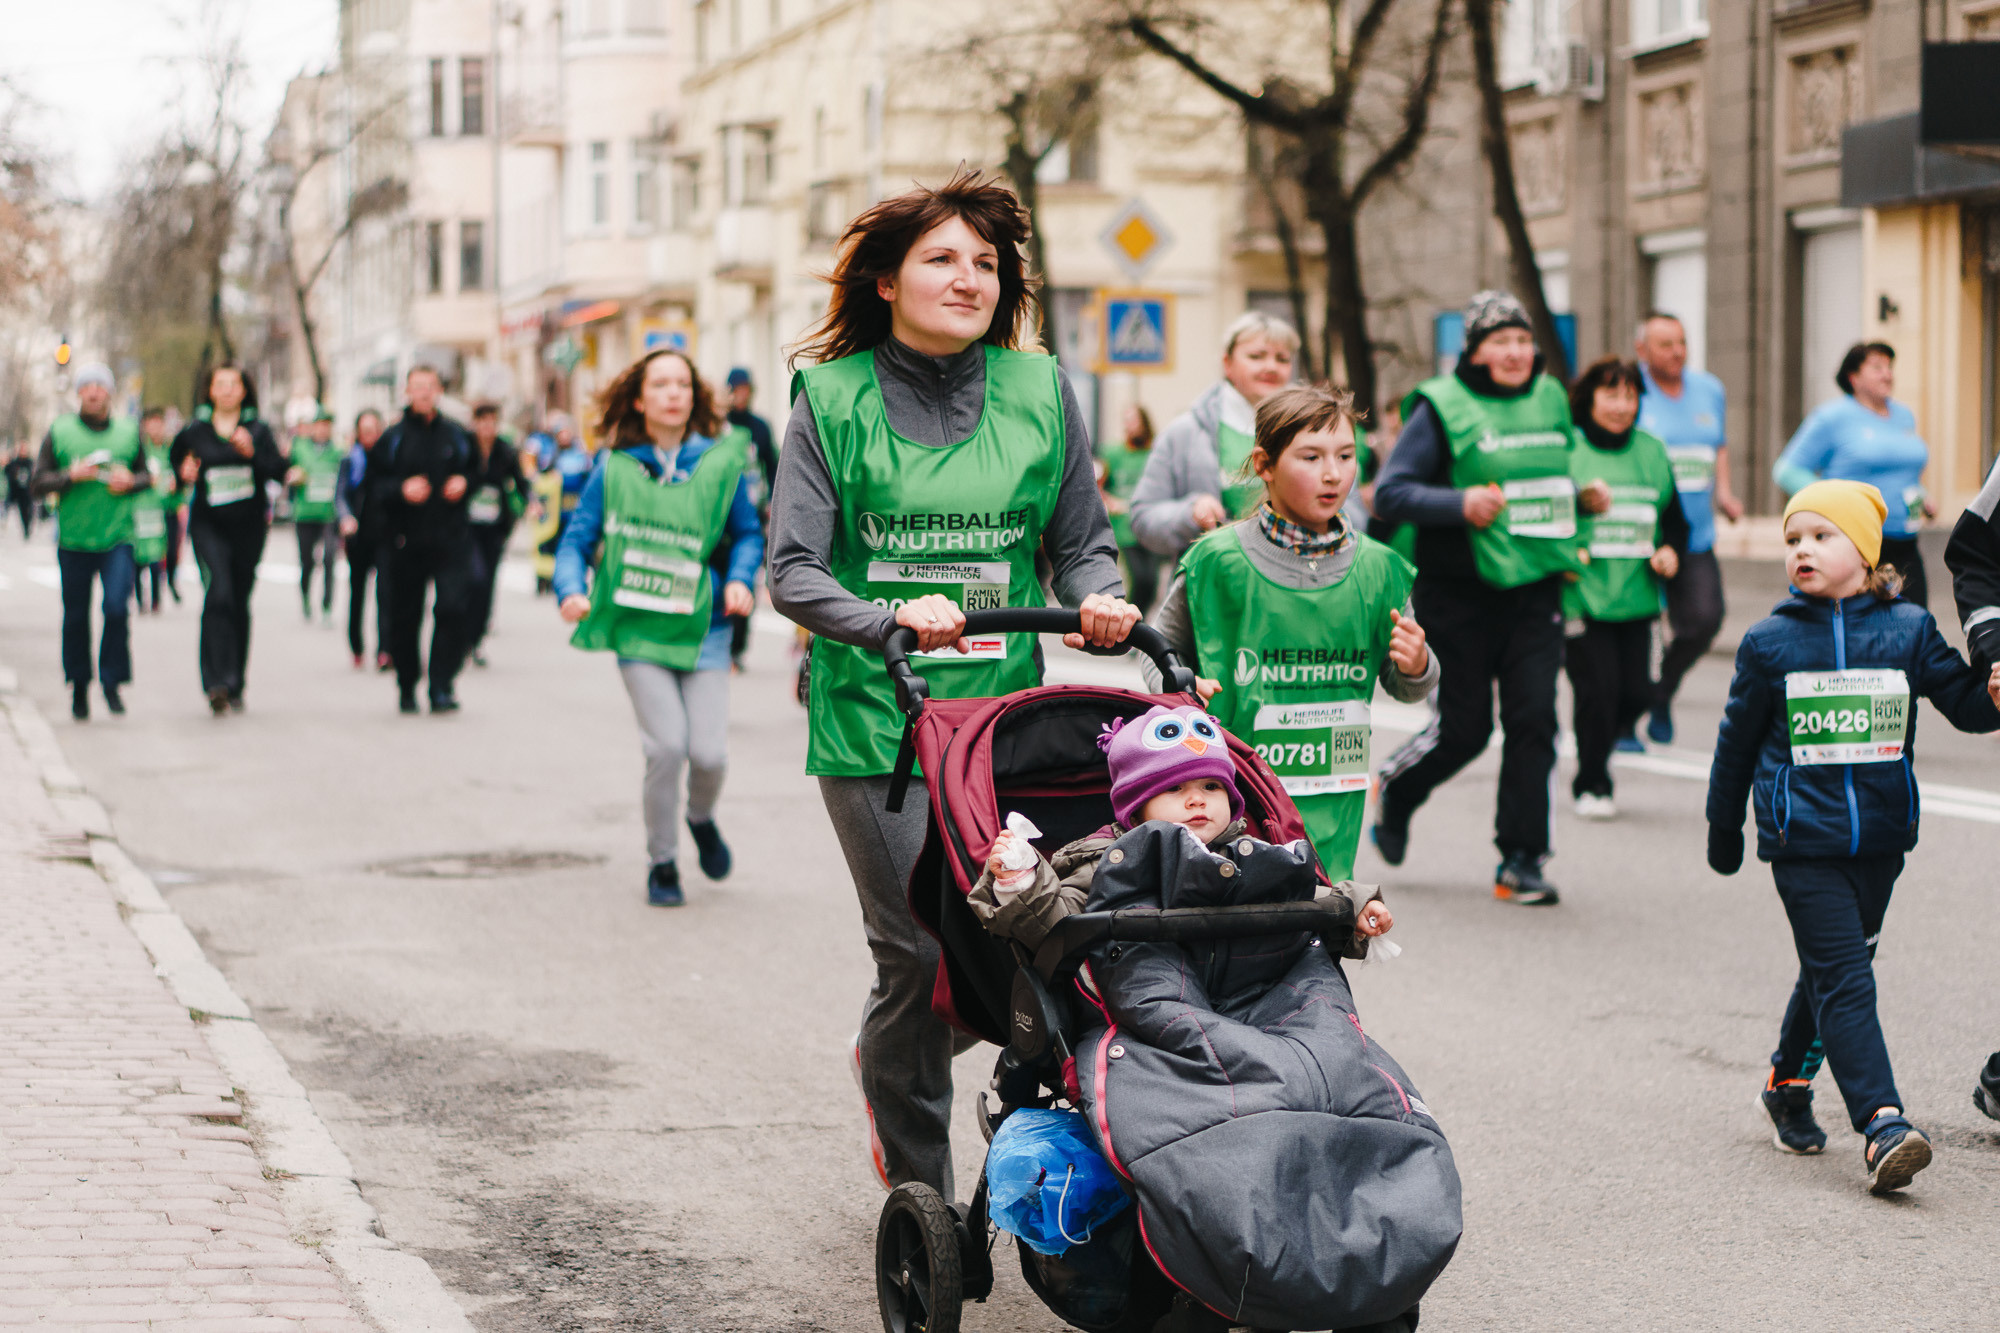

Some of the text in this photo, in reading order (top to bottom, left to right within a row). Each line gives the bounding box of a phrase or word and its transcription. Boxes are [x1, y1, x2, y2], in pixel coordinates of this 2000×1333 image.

[890, 509, 1028, 531] HERBALIFE
[888, 525, 1025, 550] NUTRITION
[917, 565, 981, 573] HERBALIFE
[967, 589, 1001, 599] FAMILY
[967, 598, 1001, 611] RUN
[1263, 649, 1369, 664] HERBALIF
[1261, 664, 1367, 682] NUTRITIO
[1294, 708, 1344, 718] HERBALIFE
[1875, 706, 1902, 719] RUN
[1294, 717, 1344, 725] NUTRITION
[1792, 709, 1869, 735] 20426
[1334, 730, 1363, 739] FAMILY
[1334, 737, 1364, 751] RUN
[1255, 742, 1327, 767] 20781
[1348, 753, 1364, 763] KM
